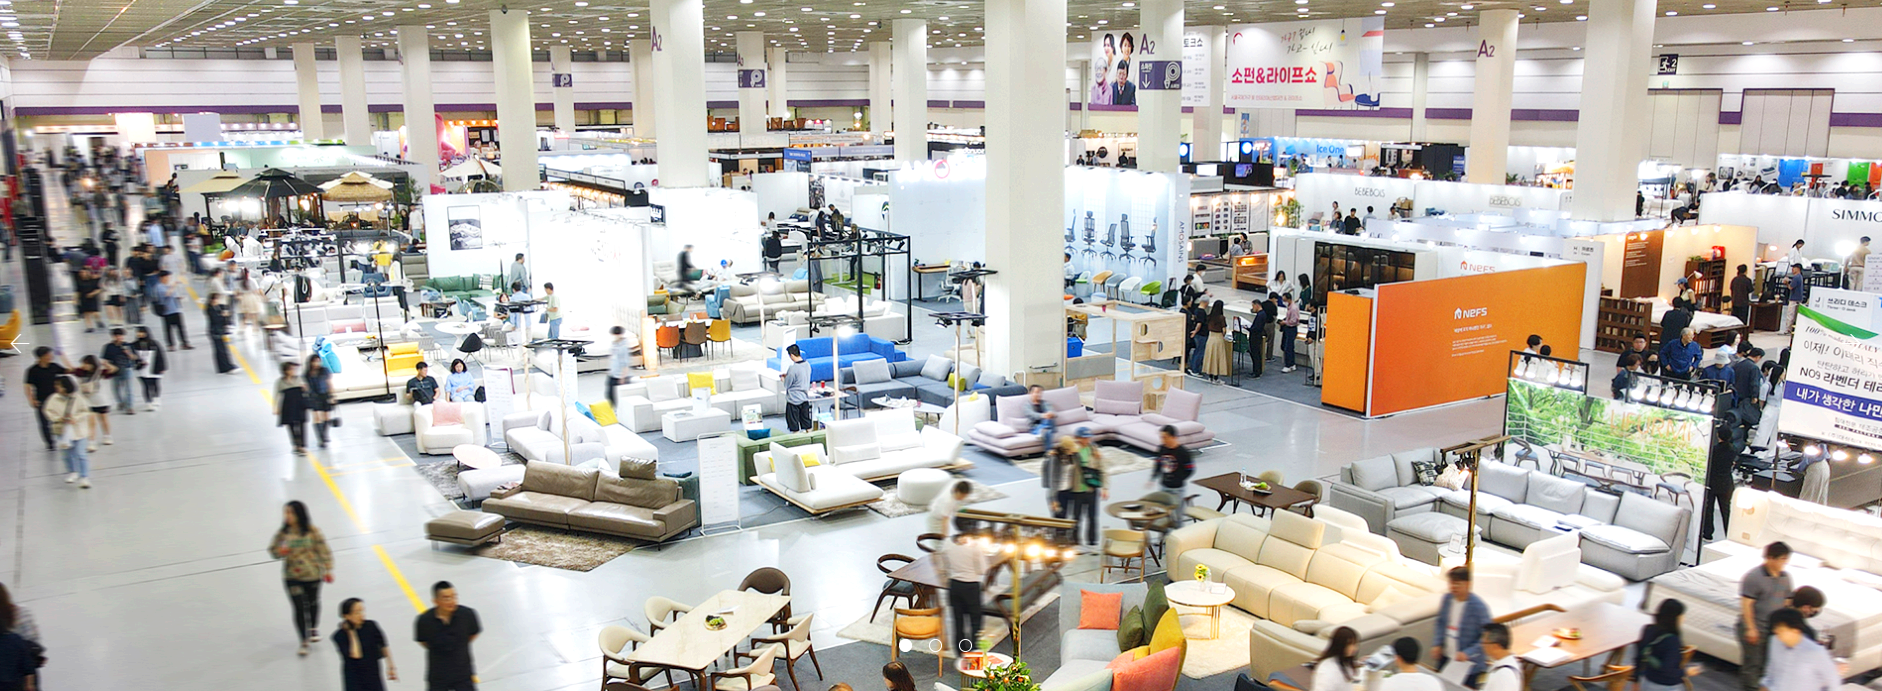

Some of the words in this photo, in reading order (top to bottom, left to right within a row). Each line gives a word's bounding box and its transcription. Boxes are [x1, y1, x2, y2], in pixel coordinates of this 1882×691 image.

[651, 26, 662, 51] A2
[1139, 33, 1155, 55] A2
[1477, 39, 1495, 57] A2
[1671, 58, 1677, 67] 2
[1232, 67, 1317, 84] 소펀&라이프쇼
[1316, 144, 1327, 154] Ice
[1329, 145, 1345, 154] One
[1804, 340, 1830, 355] 이제!
[1833, 347, 1864, 365] 이태리
[1823, 372, 1860, 390] 라벤더
[1796, 387, 1820, 403] 내가
[1822, 393, 1857, 412] 생각한
